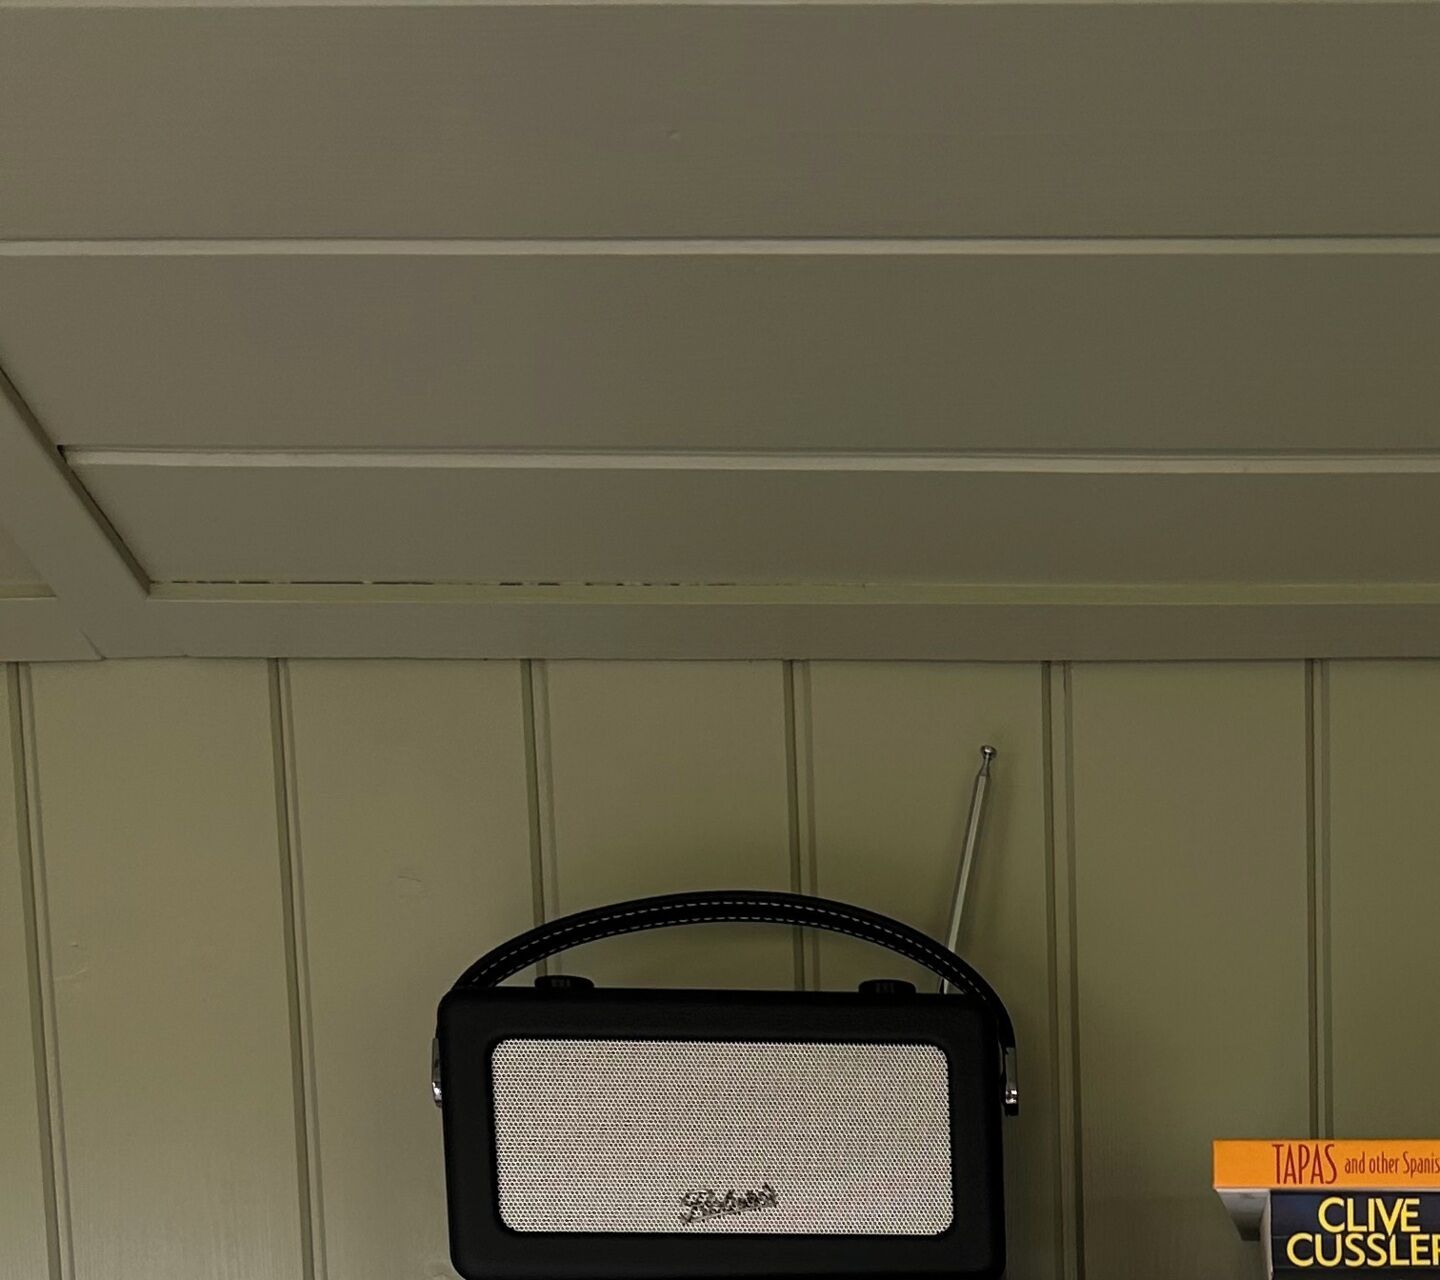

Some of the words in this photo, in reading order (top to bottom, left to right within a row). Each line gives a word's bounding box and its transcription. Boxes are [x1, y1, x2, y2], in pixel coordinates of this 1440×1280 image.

[1272, 1143, 1338, 1185] TAPAS
[1344, 1151, 1366, 1175] and
[1368, 1151, 1400, 1175] other
[1317, 1196, 1421, 1237] CLIVE
